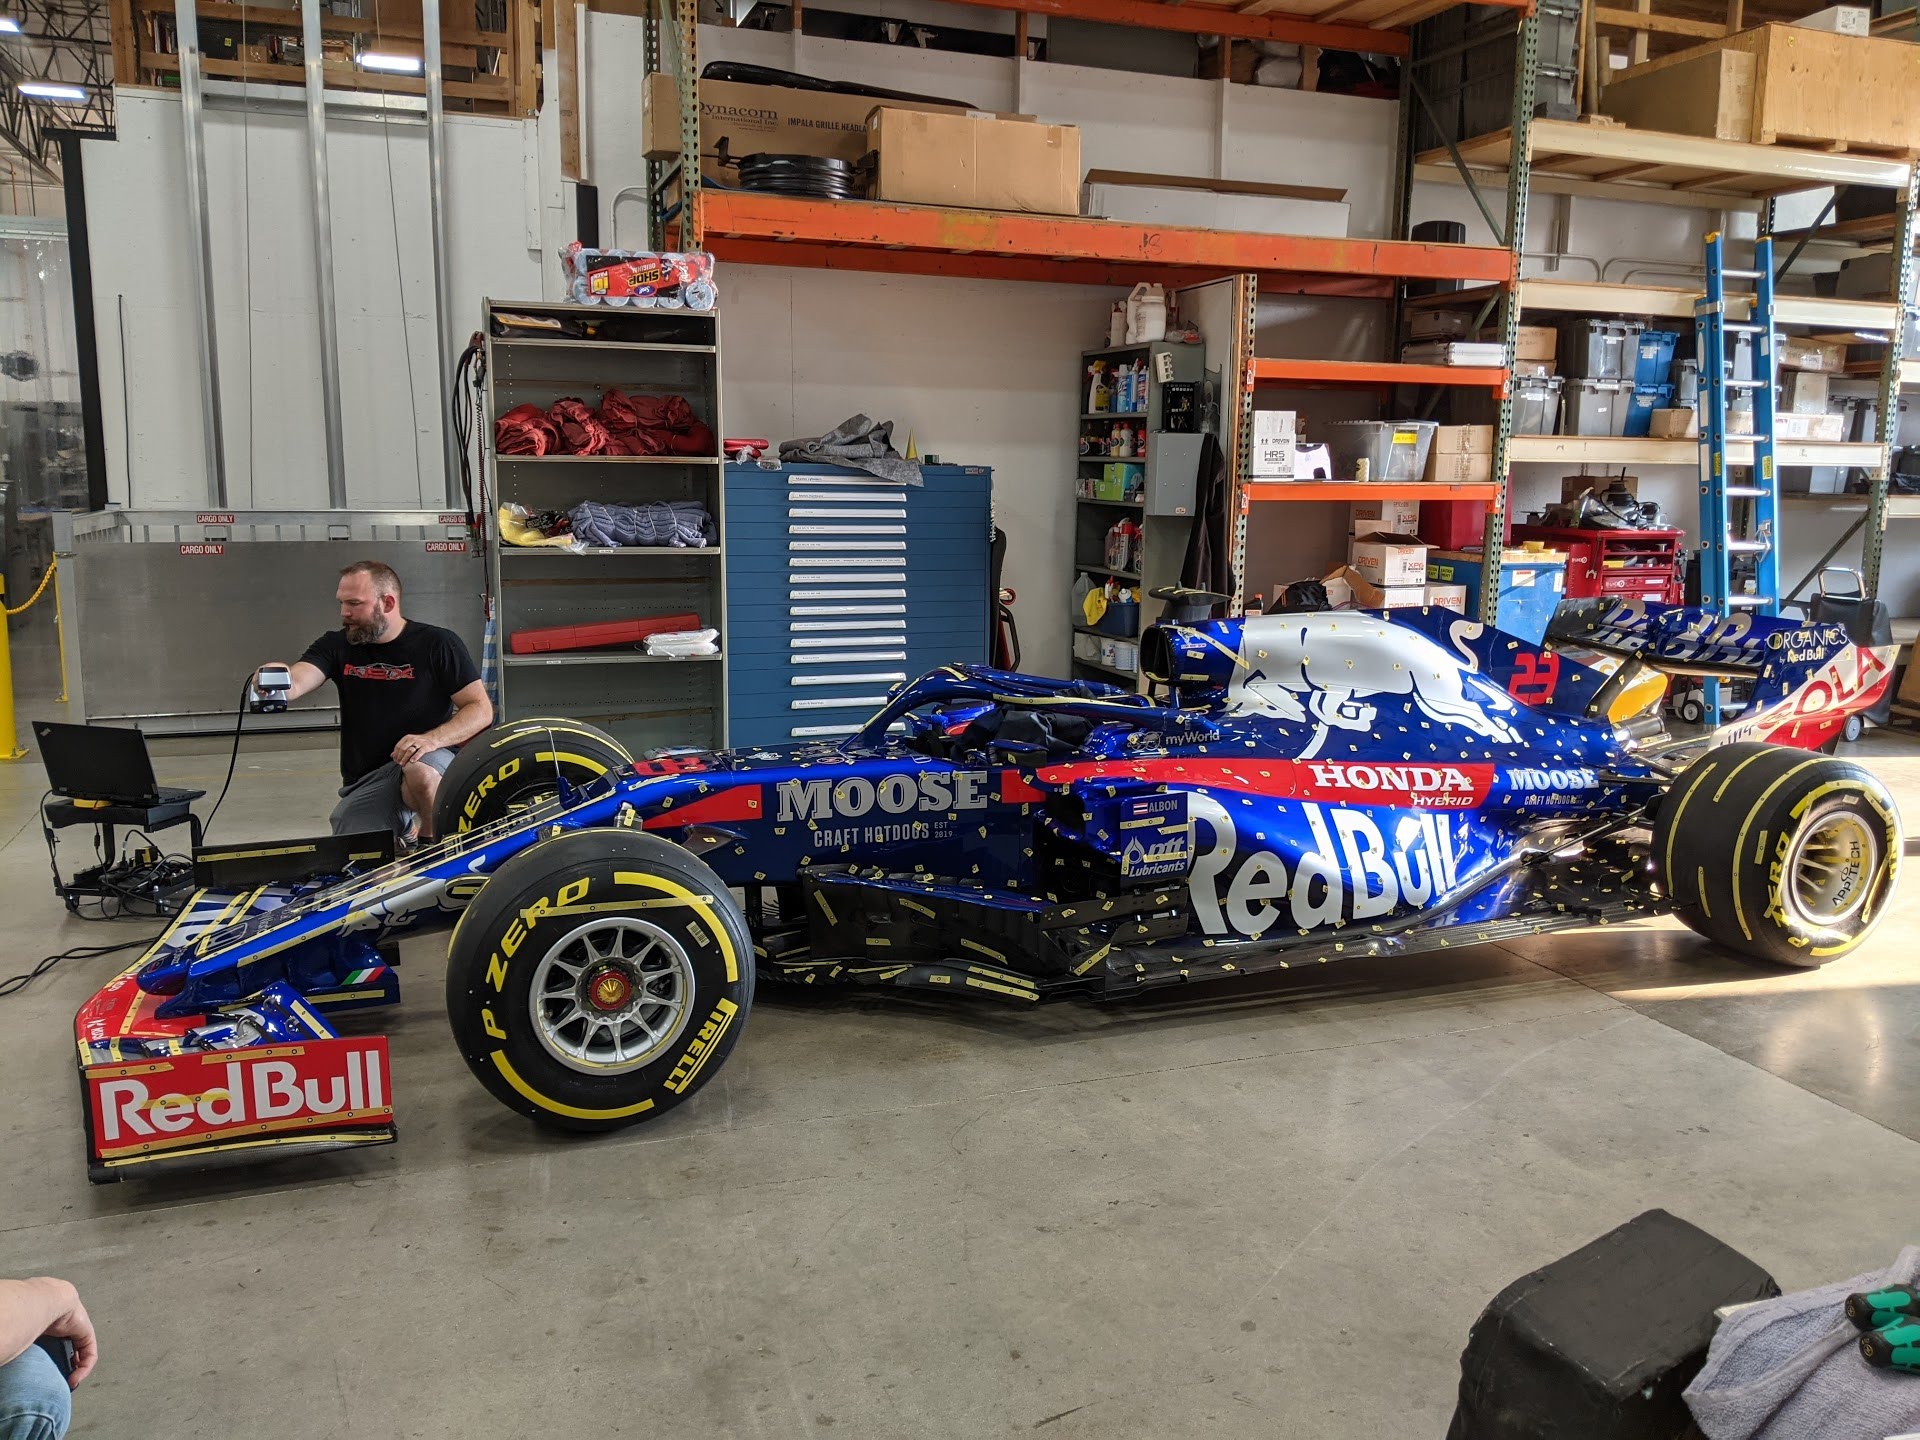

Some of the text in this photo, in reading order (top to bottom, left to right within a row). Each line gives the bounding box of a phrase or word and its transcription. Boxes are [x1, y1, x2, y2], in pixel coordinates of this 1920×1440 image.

[787, 117, 814, 128] IMPALA
[815, 119, 840, 131] GRILLE
[841, 122, 867, 133] HEADLA
[628, 269, 660, 286] SHOP
[1264, 450, 1285, 458] HR5
[197, 515, 233, 523] CARGO ONLY
[439, 515, 466, 523] CARGO ON
[180, 545, 222, 554] CARGO ONLY
[427, 543, 465, 552] CARGO ONLY
[1357, 556, 1379, 567] DRIVEN
[1433, 597, 1462, 605] DRIVEN
[1766, 628, 1848, 650] ORGANICS
[1165, 729, 1220, 746] myWorld
[1307, 764, 1475, 791] HONDA
[1507, 768, 1600, 791] MOOSE
[776, 770, 988, 822] MOOSE
[1412, 796, 1474, 807] HYBRID
[1148, 800, 1178, 813] ALBON
[934, 821, 949, 829] EST
[814, 822, 930, 848] CRAFT HOTDOGS
[1128, 861, 1186, 878] Lubricants
[481, 877, 590, 1040] P ZERO
[664, 997, 739, 1095] PIRELLI
